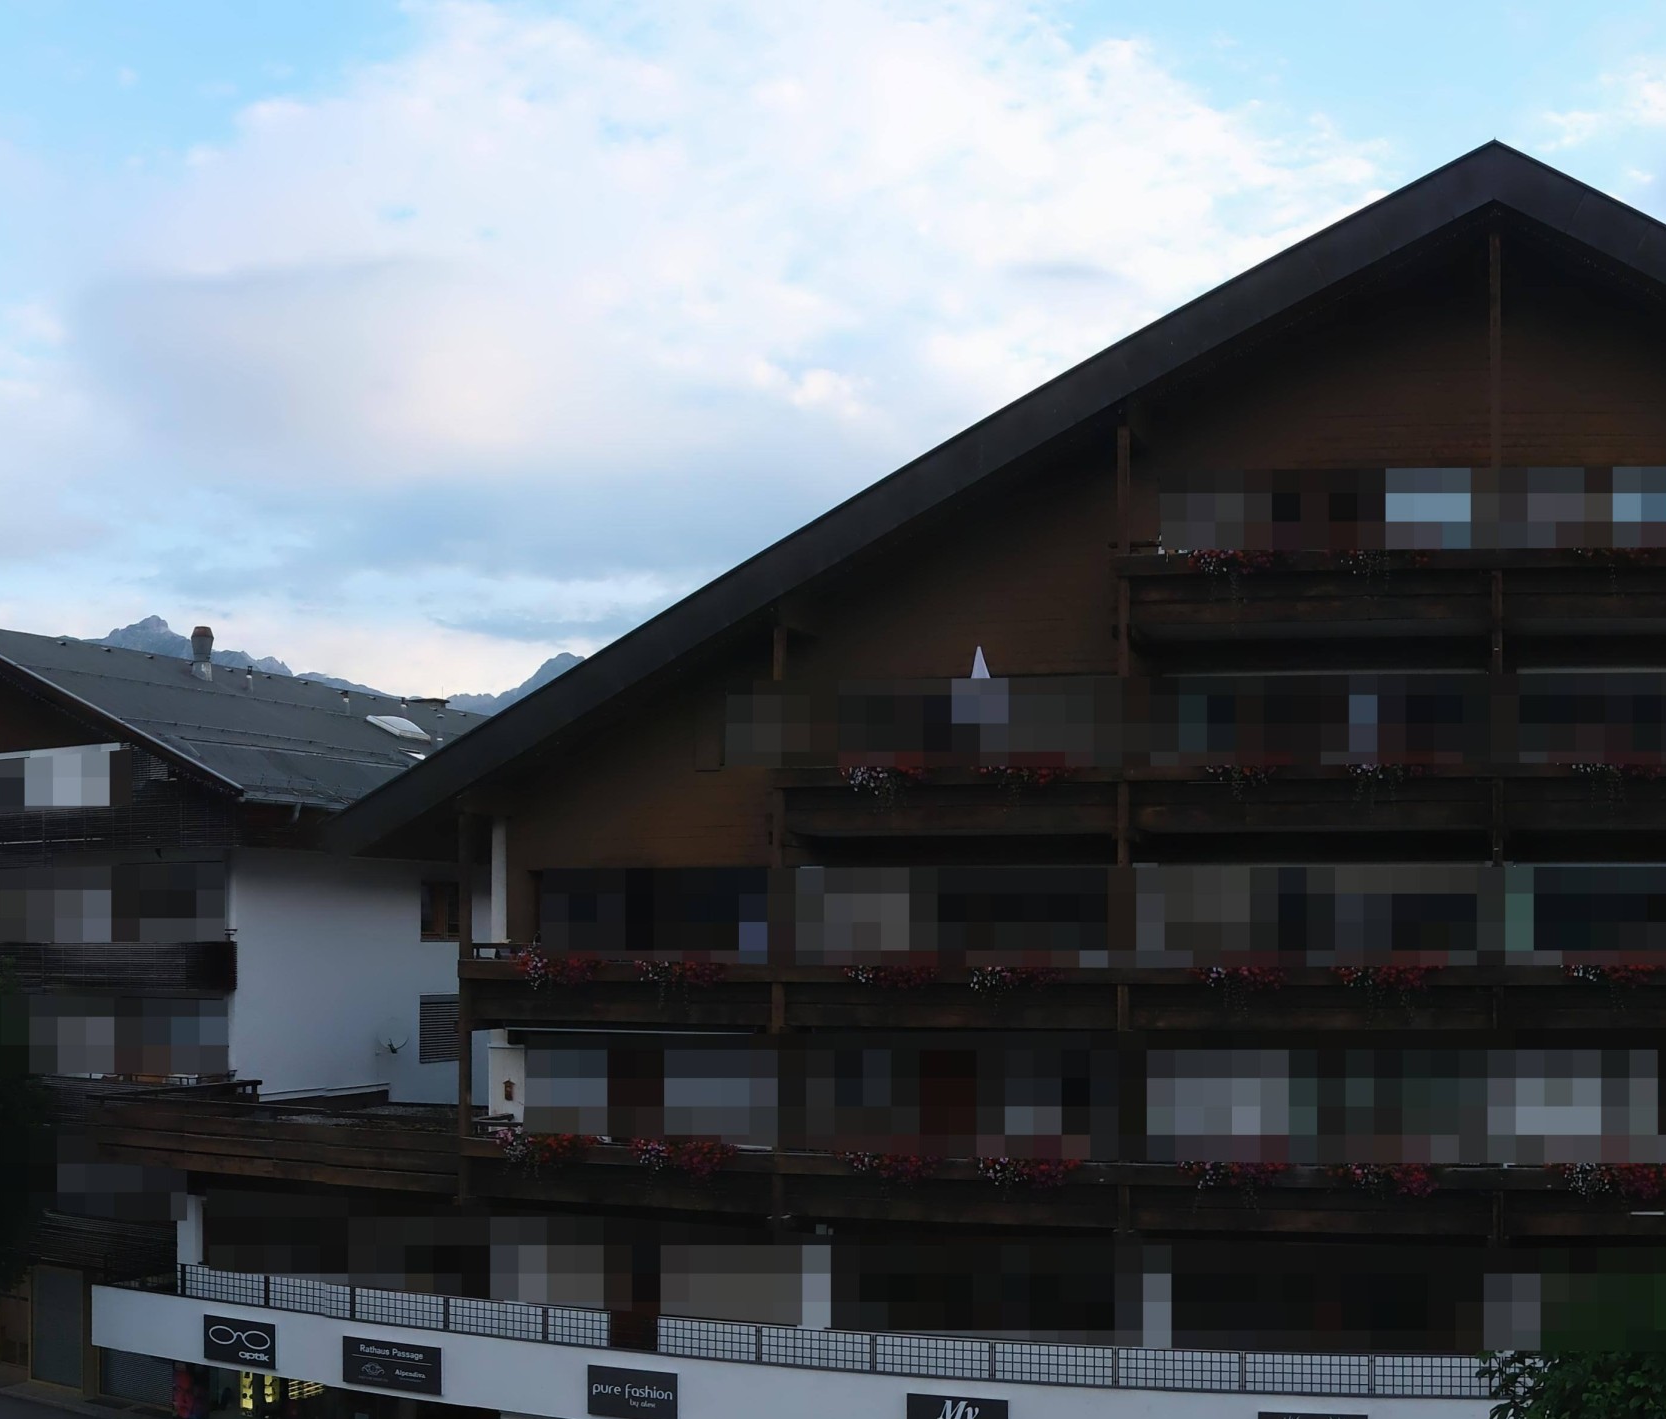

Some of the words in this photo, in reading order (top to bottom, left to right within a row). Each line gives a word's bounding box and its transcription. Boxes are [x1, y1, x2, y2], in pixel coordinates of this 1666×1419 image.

[238, 1351, 270, 1362] optik
[359, 1344, 390, 1356] Rathaus
[391, 1348, 424, 1361] Passage
[592, 1383, 622, 1396] pure
[625, 1383, 673, 1400] fashion
